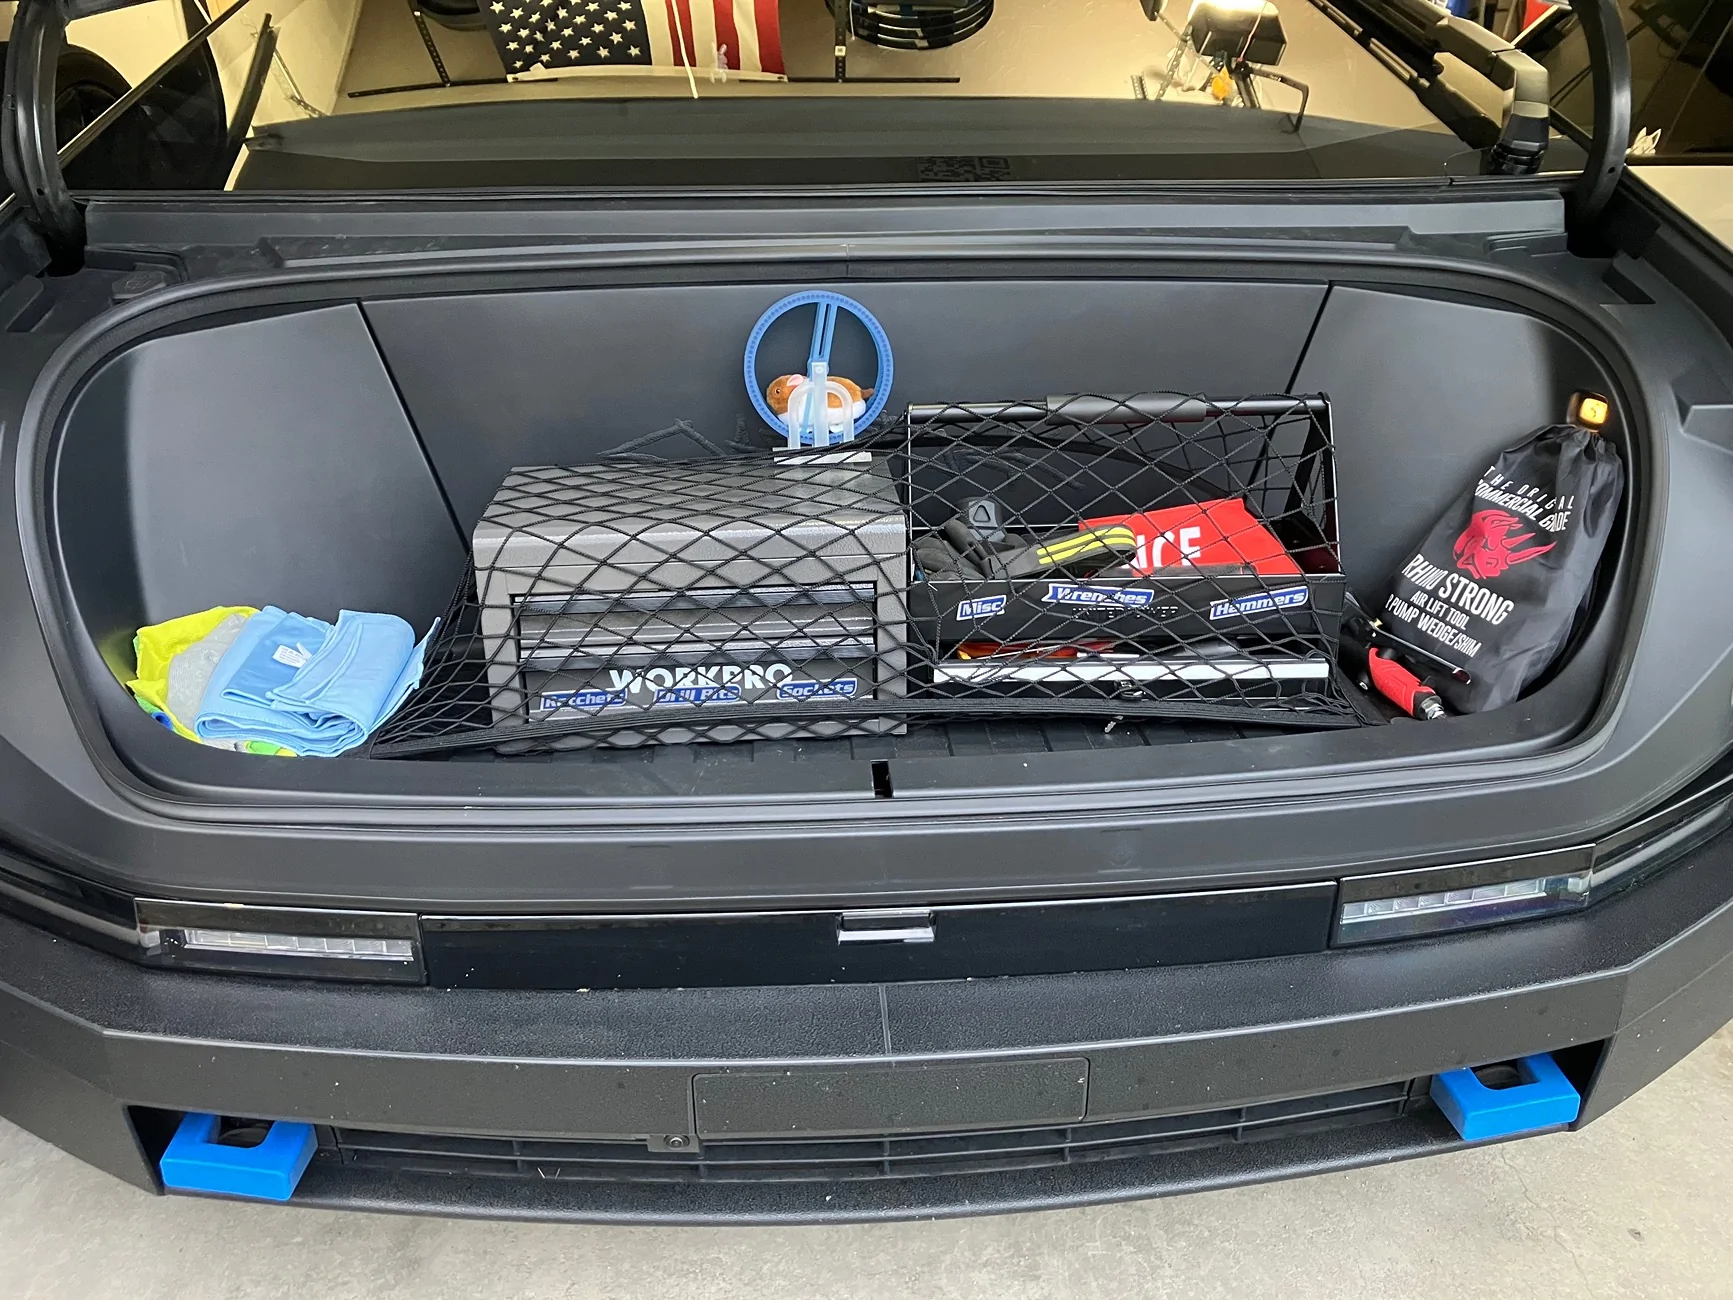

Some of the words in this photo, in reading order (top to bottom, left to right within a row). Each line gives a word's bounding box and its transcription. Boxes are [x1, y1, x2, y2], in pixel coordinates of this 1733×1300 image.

[1483, 465, 1514, 490] THE
[1057, 587, 1148, 605] Wrenhes
[1401, 553, 1449, 591] RHINO
[1438, 572, 1515, 626] STRONG
[962, 601, 1002, 616] Misc
[1215, 592, 1305, 616] Hammers
[1409, 590, 1429, 609] AIR
[1425, 597, 1449, 617] LIFT
[1445, 607, 1470, 631] TOOL
[1388, 596, 1420, 623] PUMP
[1416, 612, 1483, 658] WEDGE/SHIM
[609, 663, 793, 694] WORKPRO
[781, 683, 855, 697] Sockets
